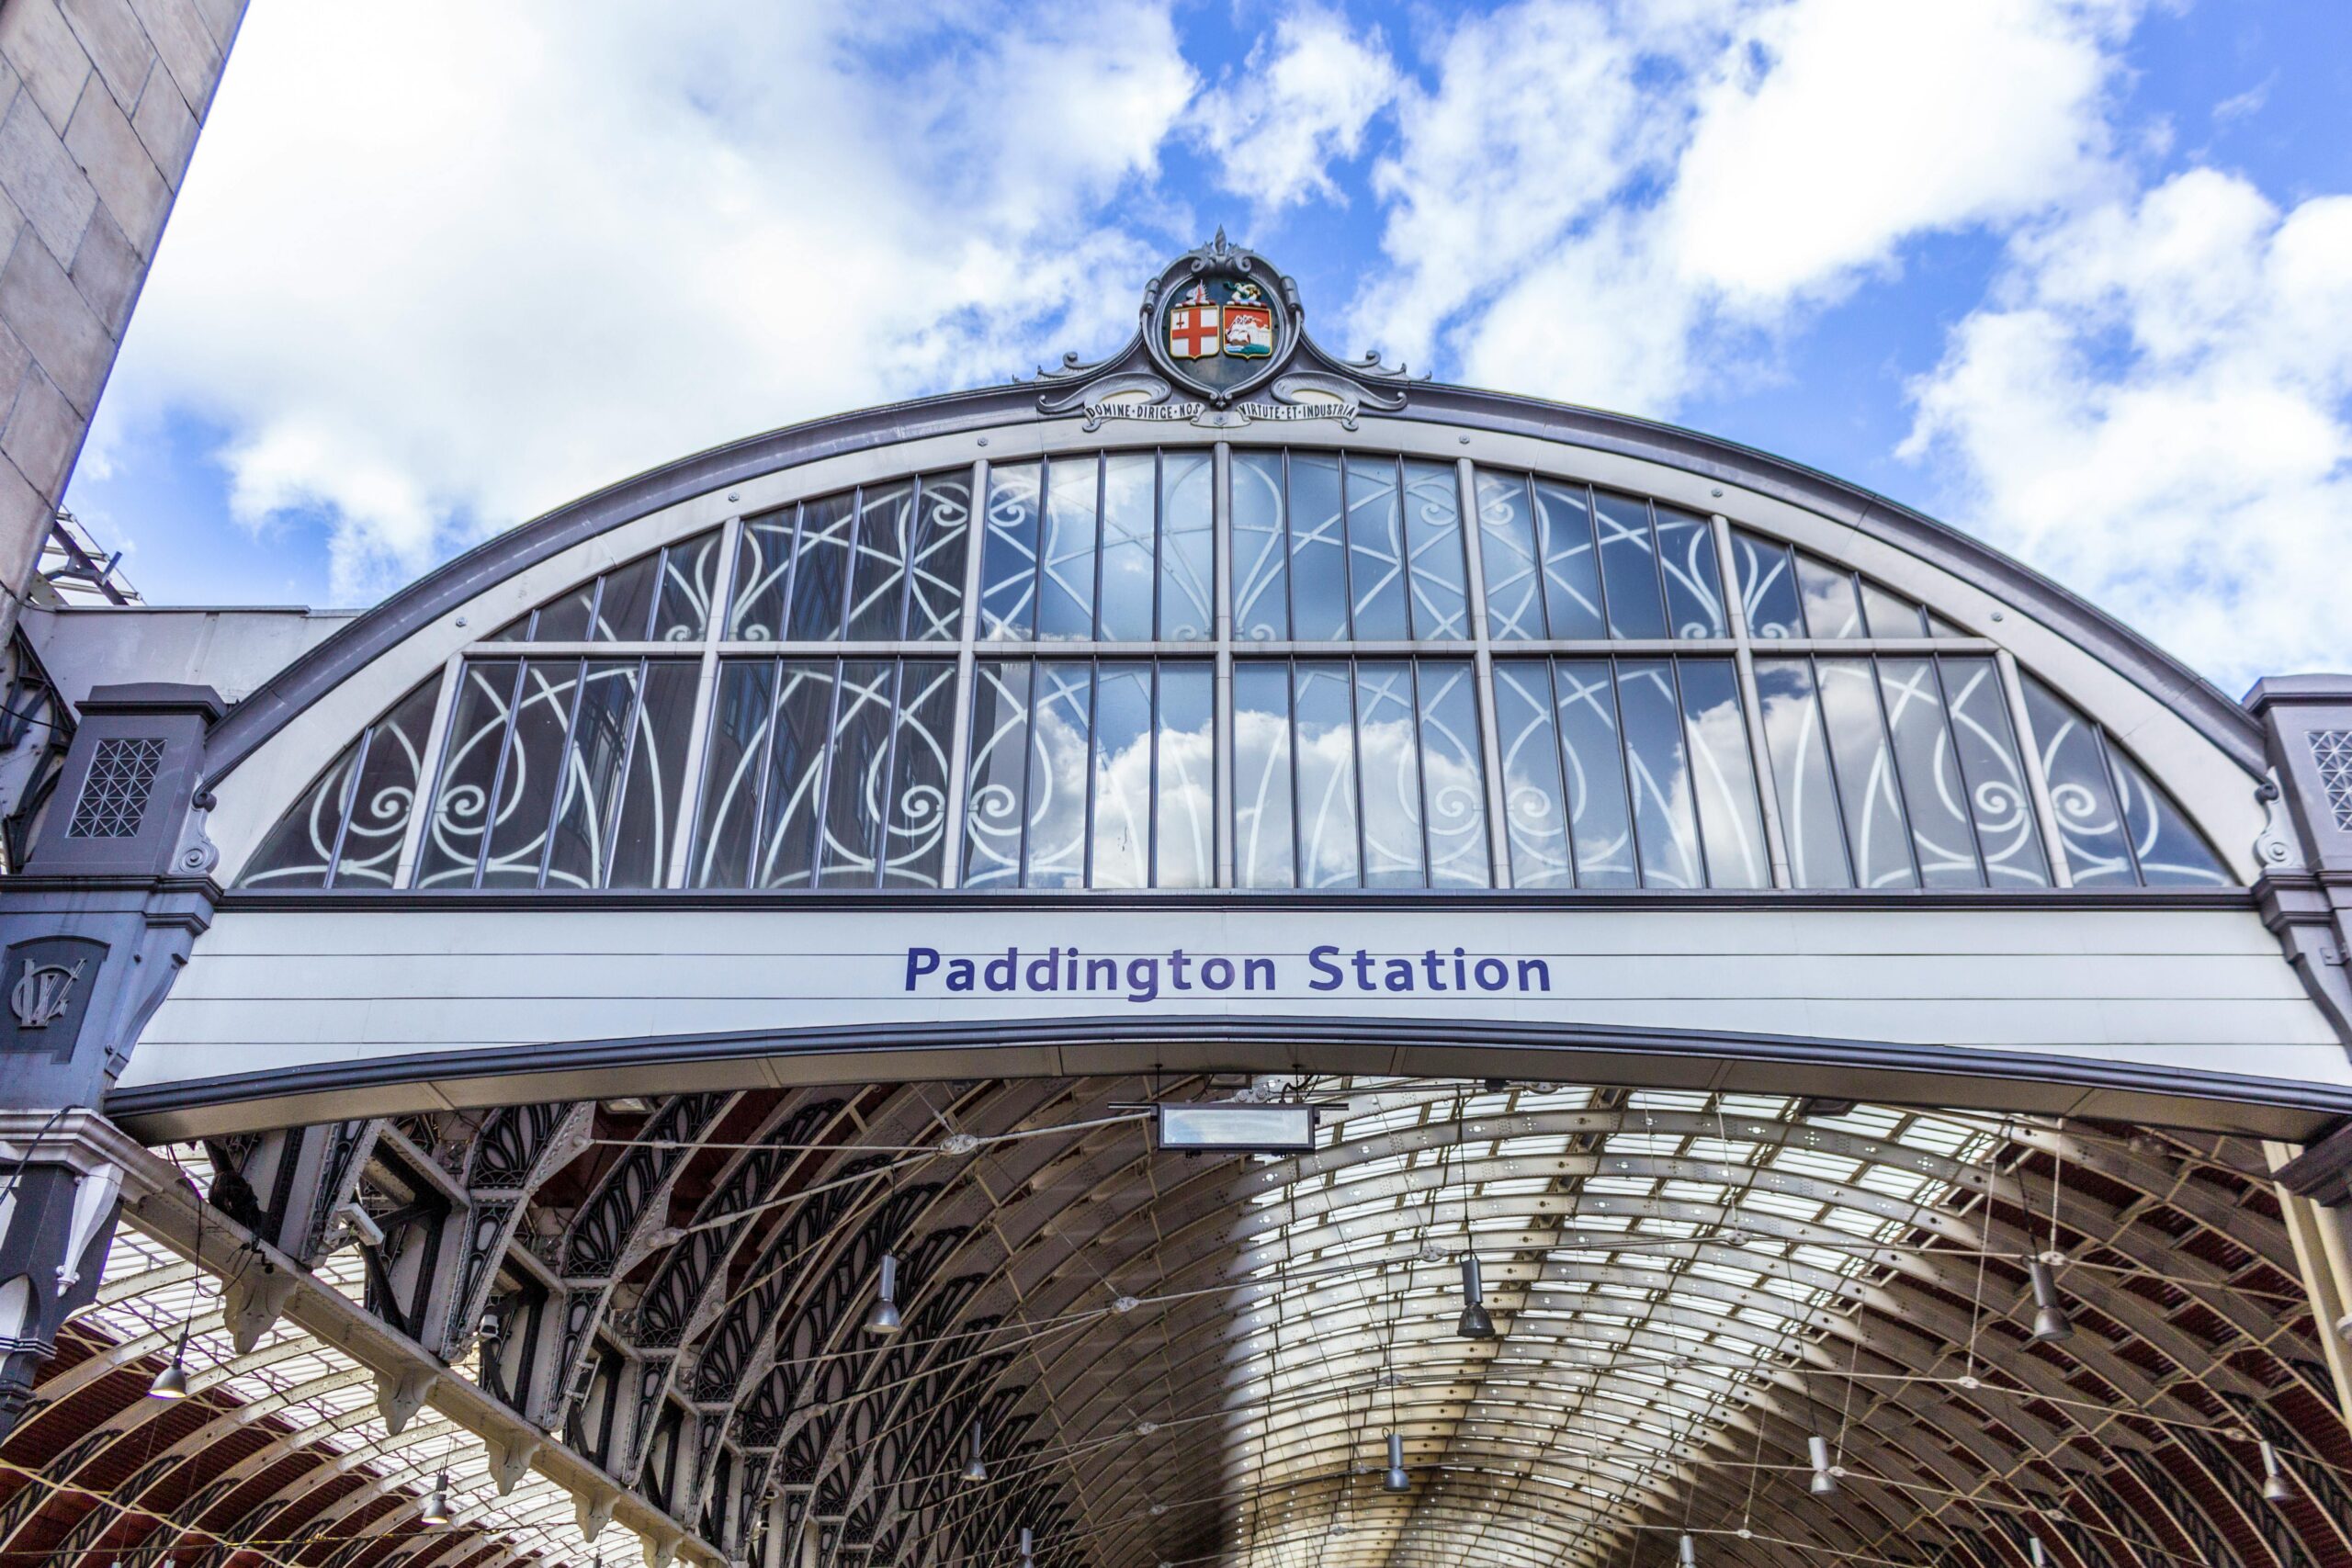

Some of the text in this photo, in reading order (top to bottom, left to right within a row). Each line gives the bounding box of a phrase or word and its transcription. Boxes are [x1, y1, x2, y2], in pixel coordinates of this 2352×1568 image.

[1086, 403, 1201, 419] DOMINE DIRIGE NOS
[1238, 403, 1355, 419] VIRTUTE ET INDUSTRIA
[906, 945, 1551, 1003] Paddington Station
